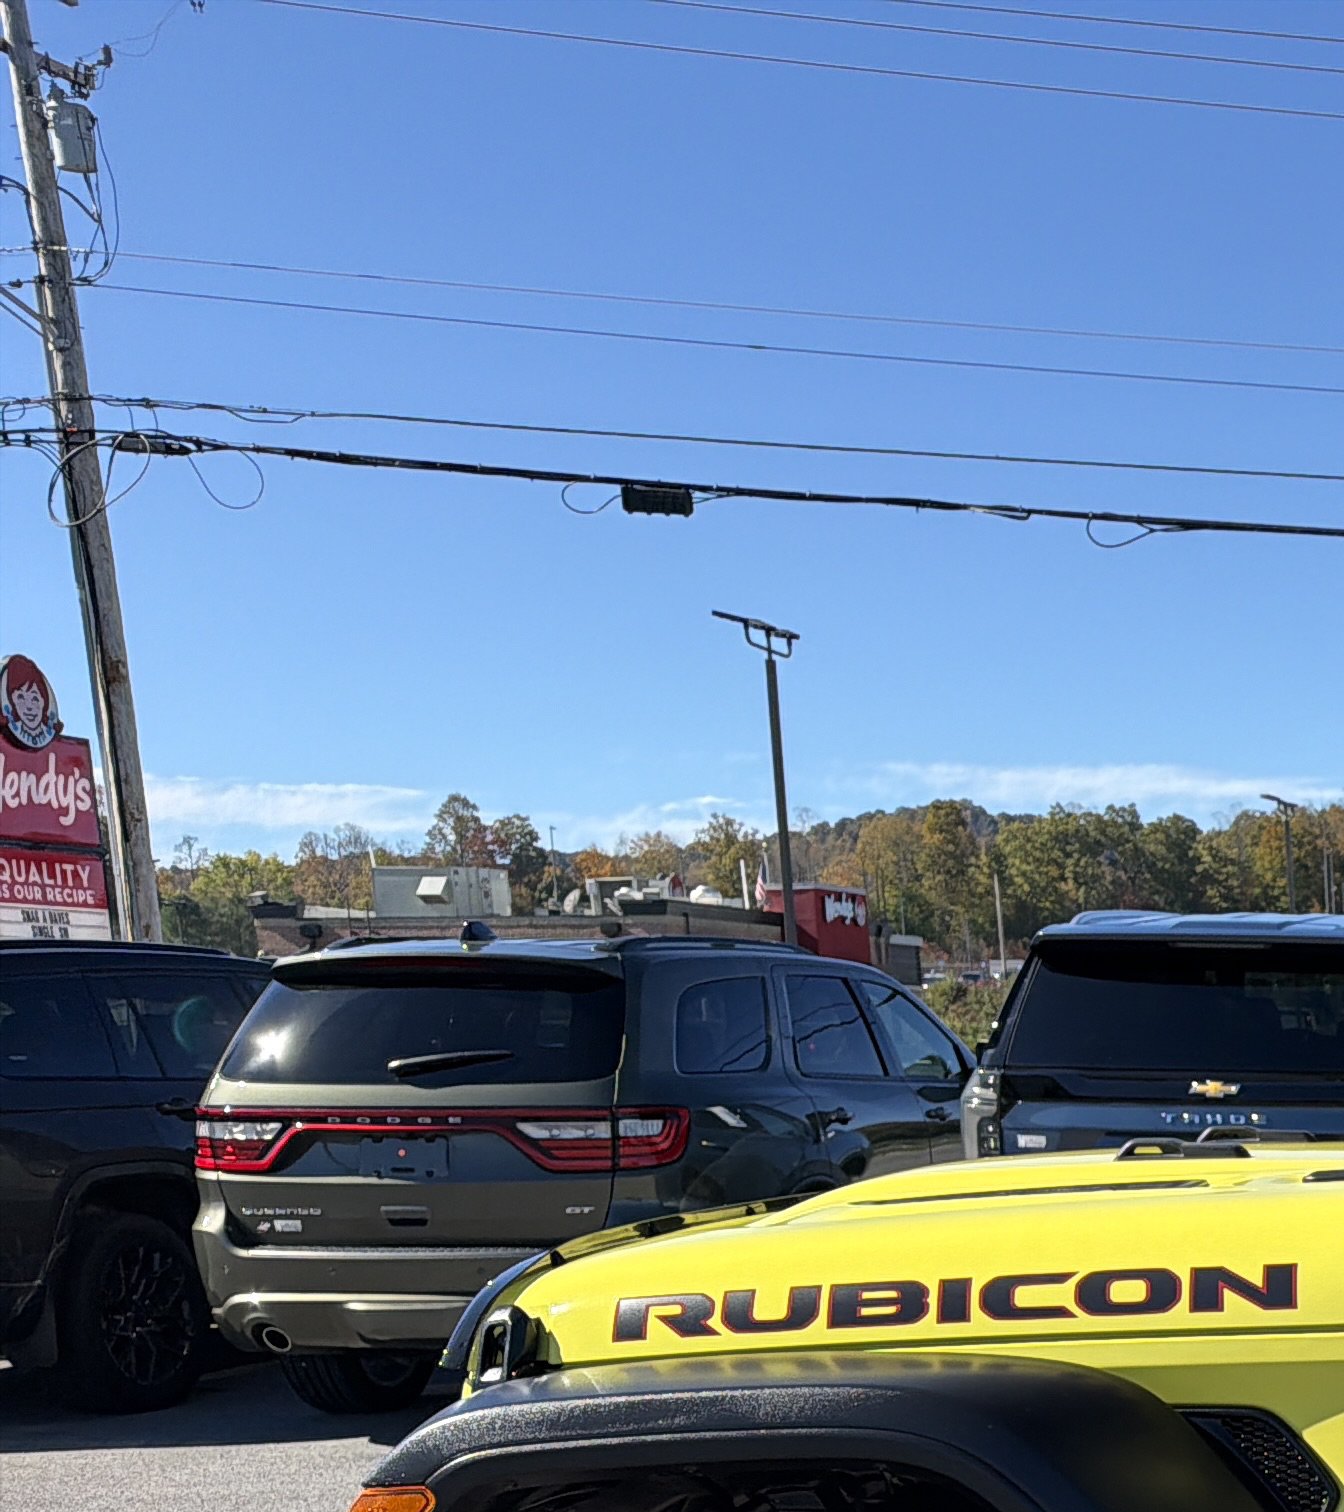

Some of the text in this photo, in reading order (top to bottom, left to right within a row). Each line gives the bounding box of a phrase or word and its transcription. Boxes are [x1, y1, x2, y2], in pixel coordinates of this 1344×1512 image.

[0, 752, 91, 826] endy's
[0, 858, 91, 888] QUALITY
[14, 885, 43, 901] OUR
[46, 887, 95, 905] RECIPE
[327, 1115, 463, 1125] DODGE
[564, 1205, 596, 1215] GT
[611, 1263, 1299, 1343] RUBICON
